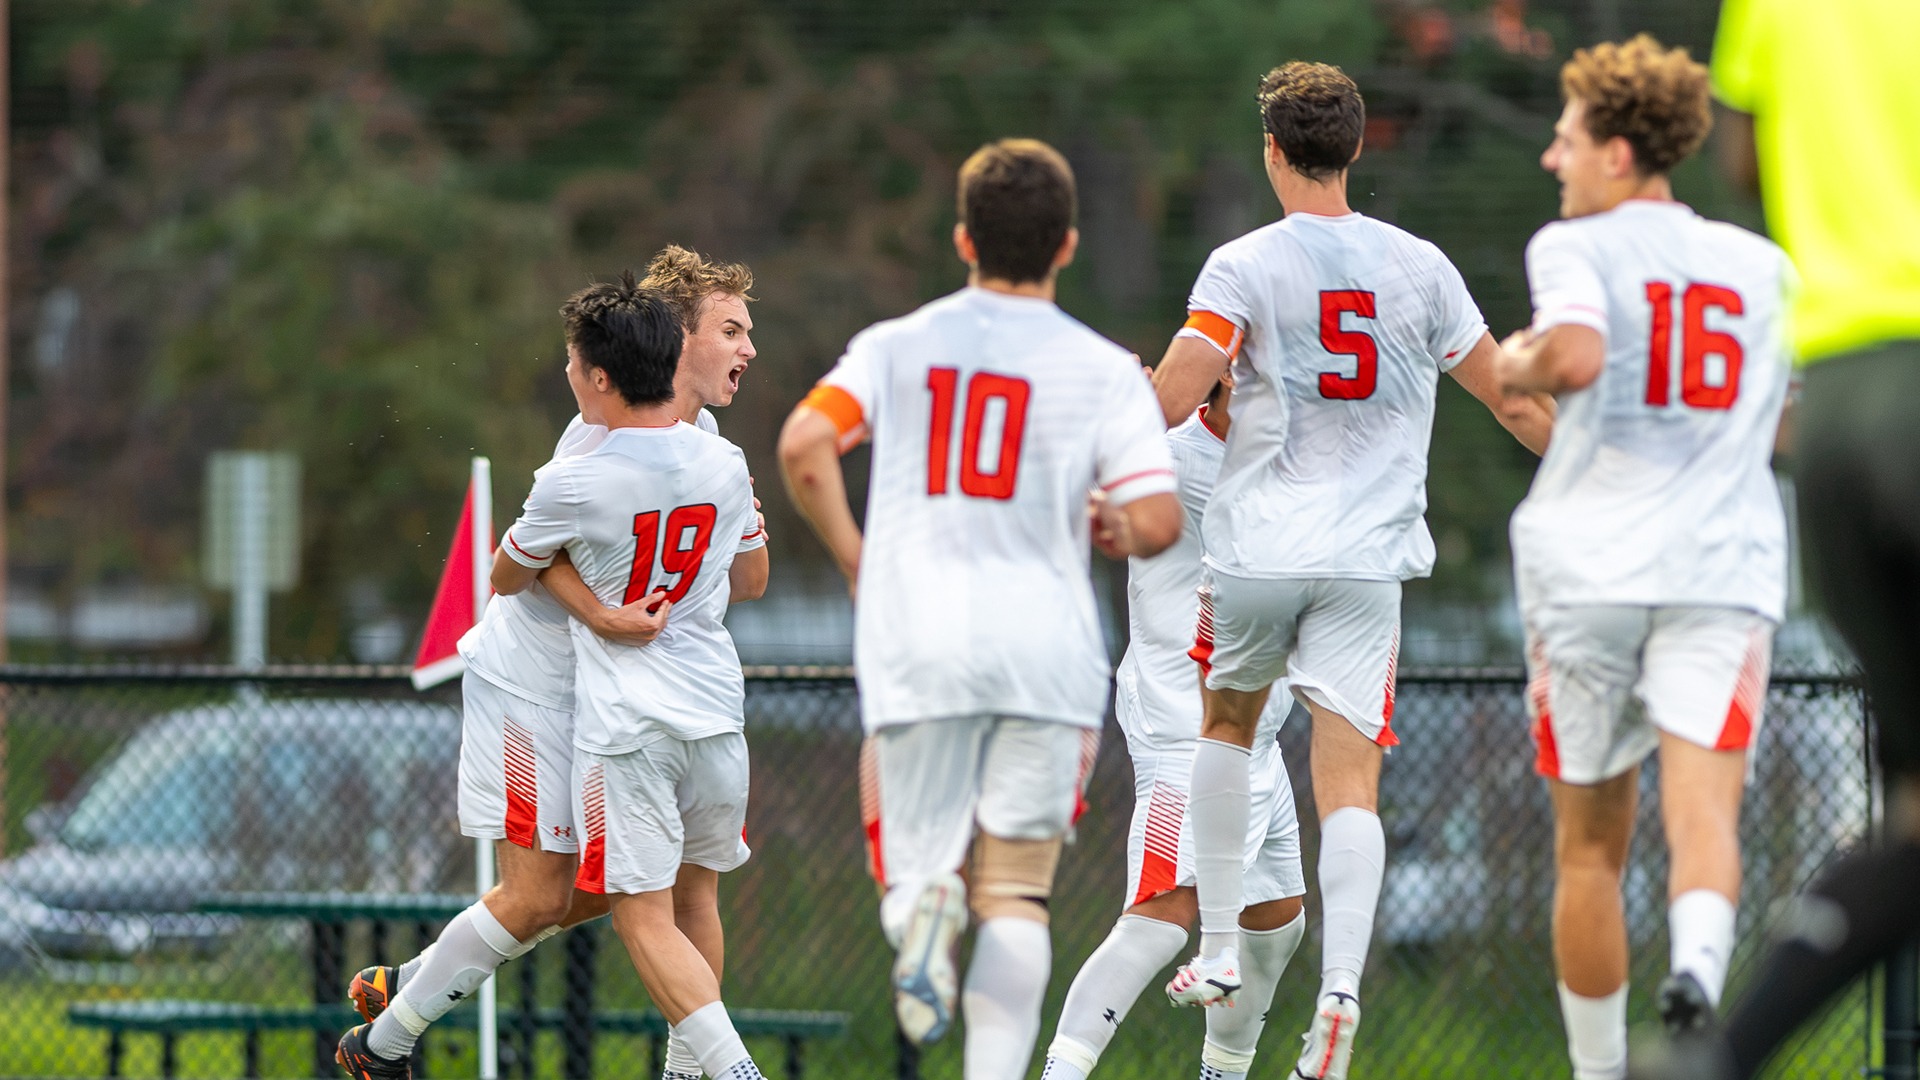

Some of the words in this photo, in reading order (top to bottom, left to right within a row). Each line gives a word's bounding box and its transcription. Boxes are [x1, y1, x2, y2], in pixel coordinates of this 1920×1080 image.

[1319, 290, 1378, 400] 5
[1644, 280, 1745, 410] 16
[926, 366, 1031, 501] 10
[622, 503, 717, 613] 19
